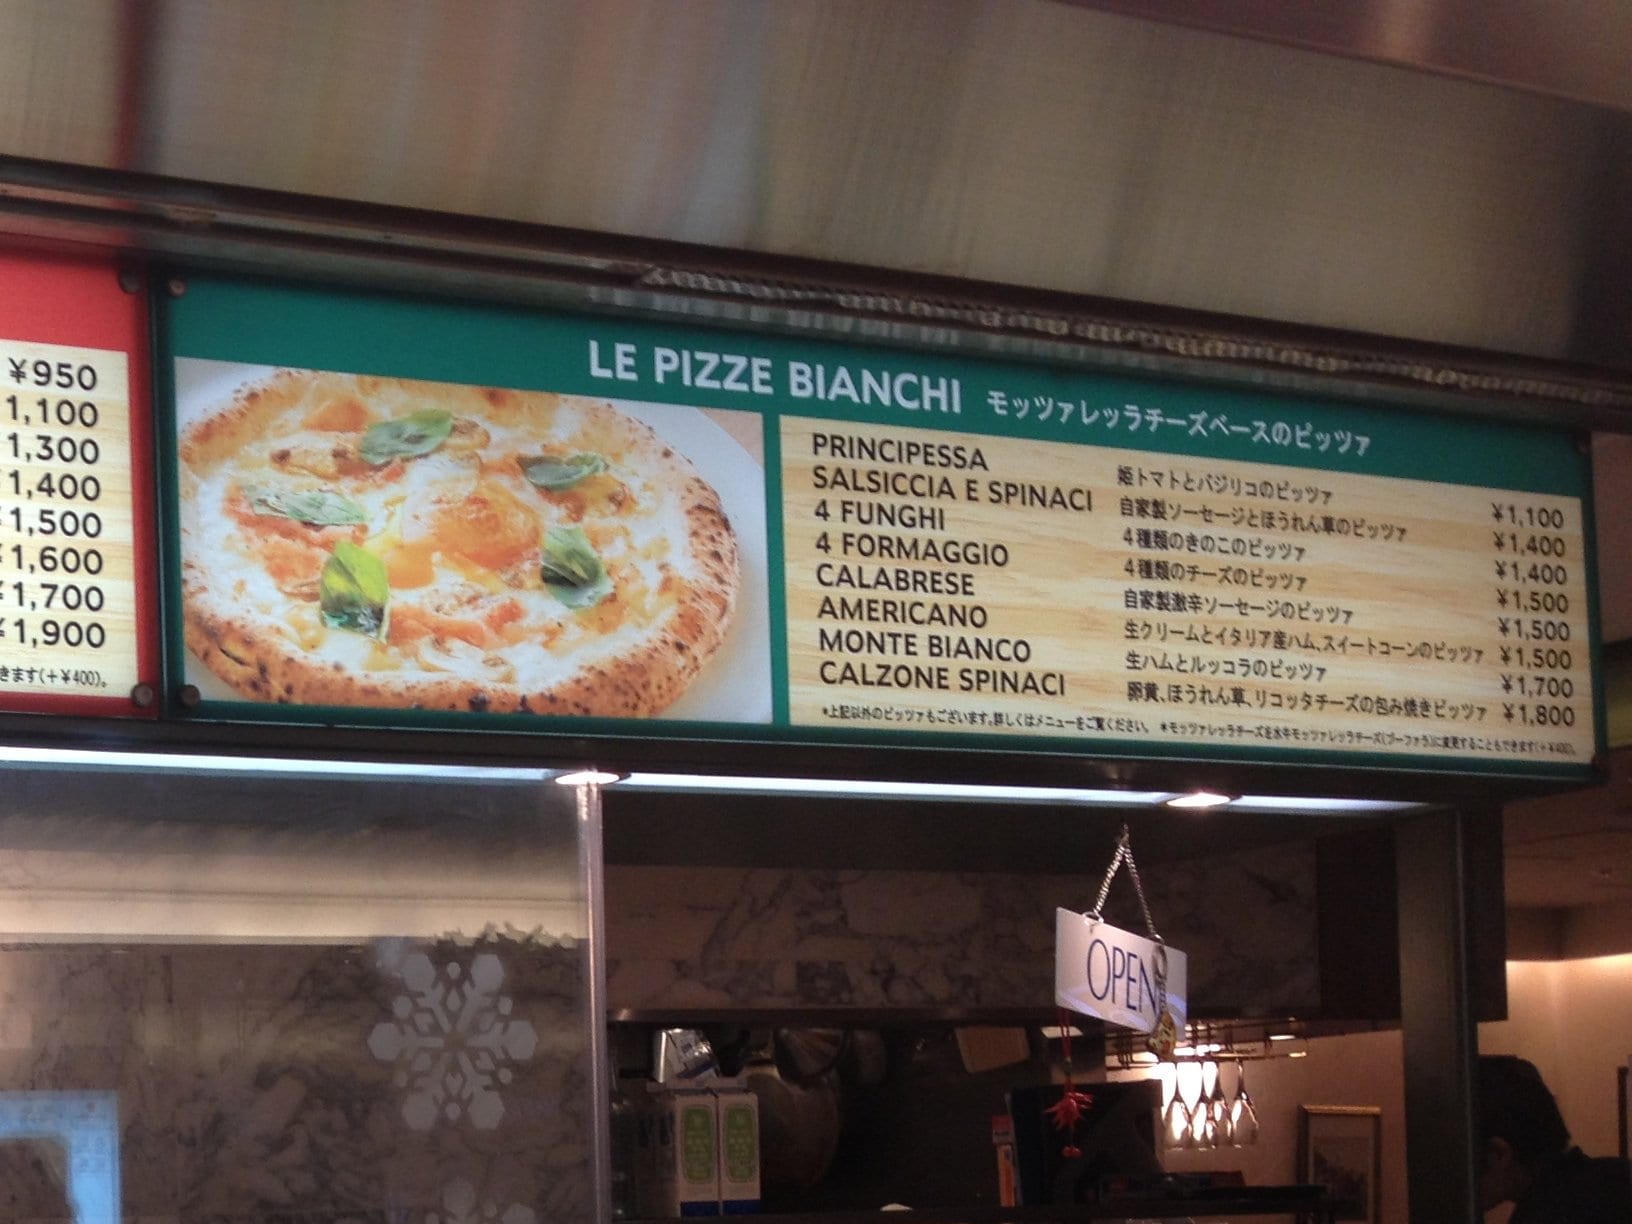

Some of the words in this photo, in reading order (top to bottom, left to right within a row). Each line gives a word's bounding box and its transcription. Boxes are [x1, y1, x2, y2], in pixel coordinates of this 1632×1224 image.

[8, 357, 99, 393] ¥950
[587, 339, 639, 382] LE
[653, 345, 774, 395] PIZZE
[788, 361, 962, 415] BIANCHI
[985, 389, 1372, 458] モッツァレッラチーズベースのピッツァ
[811, 432, 990, 472] PRINCIPESSA
[812, 465, 956, 500] SALSICCIA
[965, 480, 980, 502] E
[988, 481, 1094, 512] SPINACI
[814, 500, 831, 522] 4
[840, 500, 946, 531] FUNGHI
[1490, 502, 1564, 530] ¥1,100
[816, 532, 832, 555] 4
[842, 532, 1010, 568] FORMAGGIO
[1493, 531, 1566, 558] ¥1,400
[816, 563, 976, 597] CALABRESE
[1494, 559, 1568, 586] ¥1,400
[817, 595, 989, 629] AMERICANO
[1496, 587, 1569, 614] ¥1,500
[819, 628, 918, 658] MONTE
[928, 634, 1032, 664] BIANCO
[1498, 616, 1571, 643] ¥1,500
[1499, 644, 1572, 671] ¥1,500
[819, 661, 950, 691] CALZONE
[958, 668, 1066, 697] SPINACI
[1501, 673, 1574, 699] ¥1,700
[1502, 702, 1576, 728] ¥1,800
[1087, 939, 1158, 1015] OPEN
